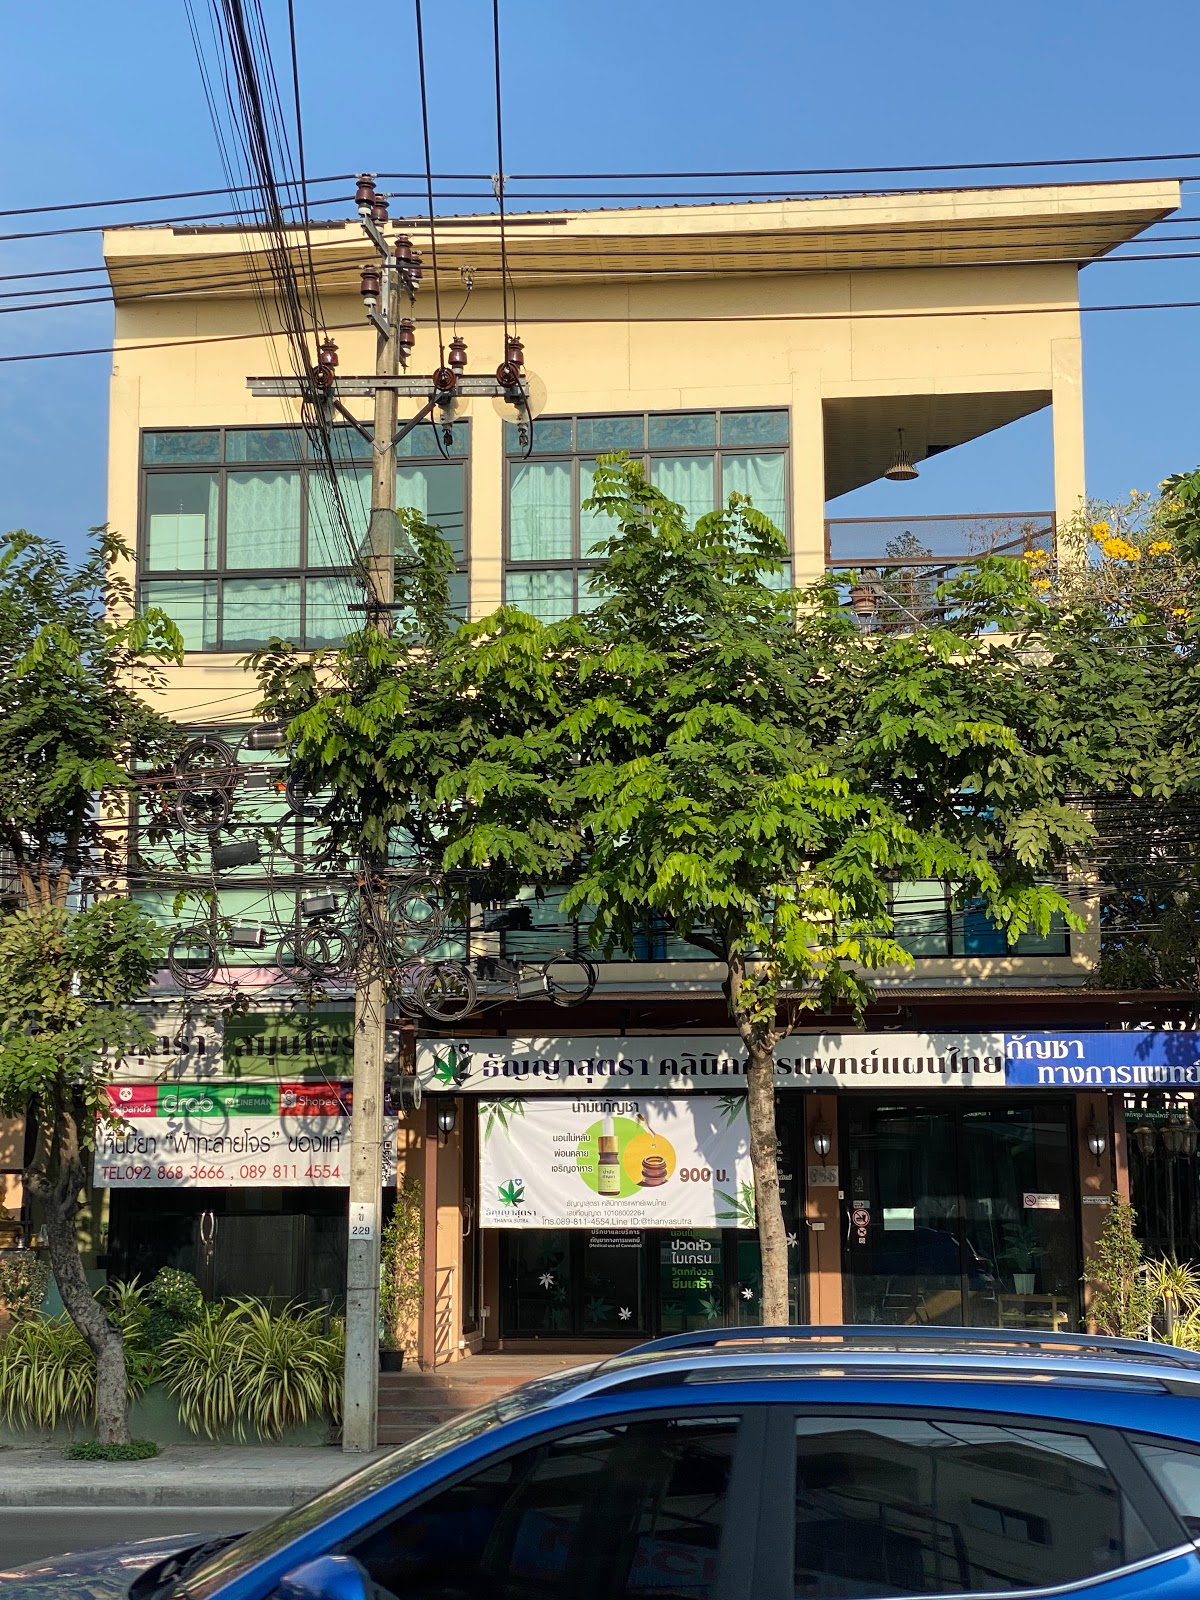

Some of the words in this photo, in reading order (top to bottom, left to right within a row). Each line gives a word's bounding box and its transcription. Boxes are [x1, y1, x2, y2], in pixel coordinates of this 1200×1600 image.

[1006, 1034, 1086, 1060] กัญชา
[482, 1052, 650, 1084] ธัญญาสุตรา
[658, 1046, 1002, 1075] คลินิกรแพทย์แผนไทย
[162, 1093, 214, 1113] Grab
[299, 1095, 338, 1107] Shopee
[288, 1131, 342, 1153] ของแท้
[552, 1132, 591, 1142] นอนไม่หลับ
[157, 1165, 183, 1179] 868
[189, 1165, 224, 1179] 3666
[239, 1164, 267, 1179] 089
[273, 1164, 297, 1178] 811
[304, 1164, 340, 1179] 4554
[551, 1164, 593, 1174] เจริญอาหาร
[679, 1167, 711, 1182] 900
[716, 1168, 730, 1182] บ.
[671, 1239, 712, 1251] ปวดหัว
[671, 1251, 712, 1264] ไมเกรน
[671, 1266, 714, 1276] วิตกกังวล
